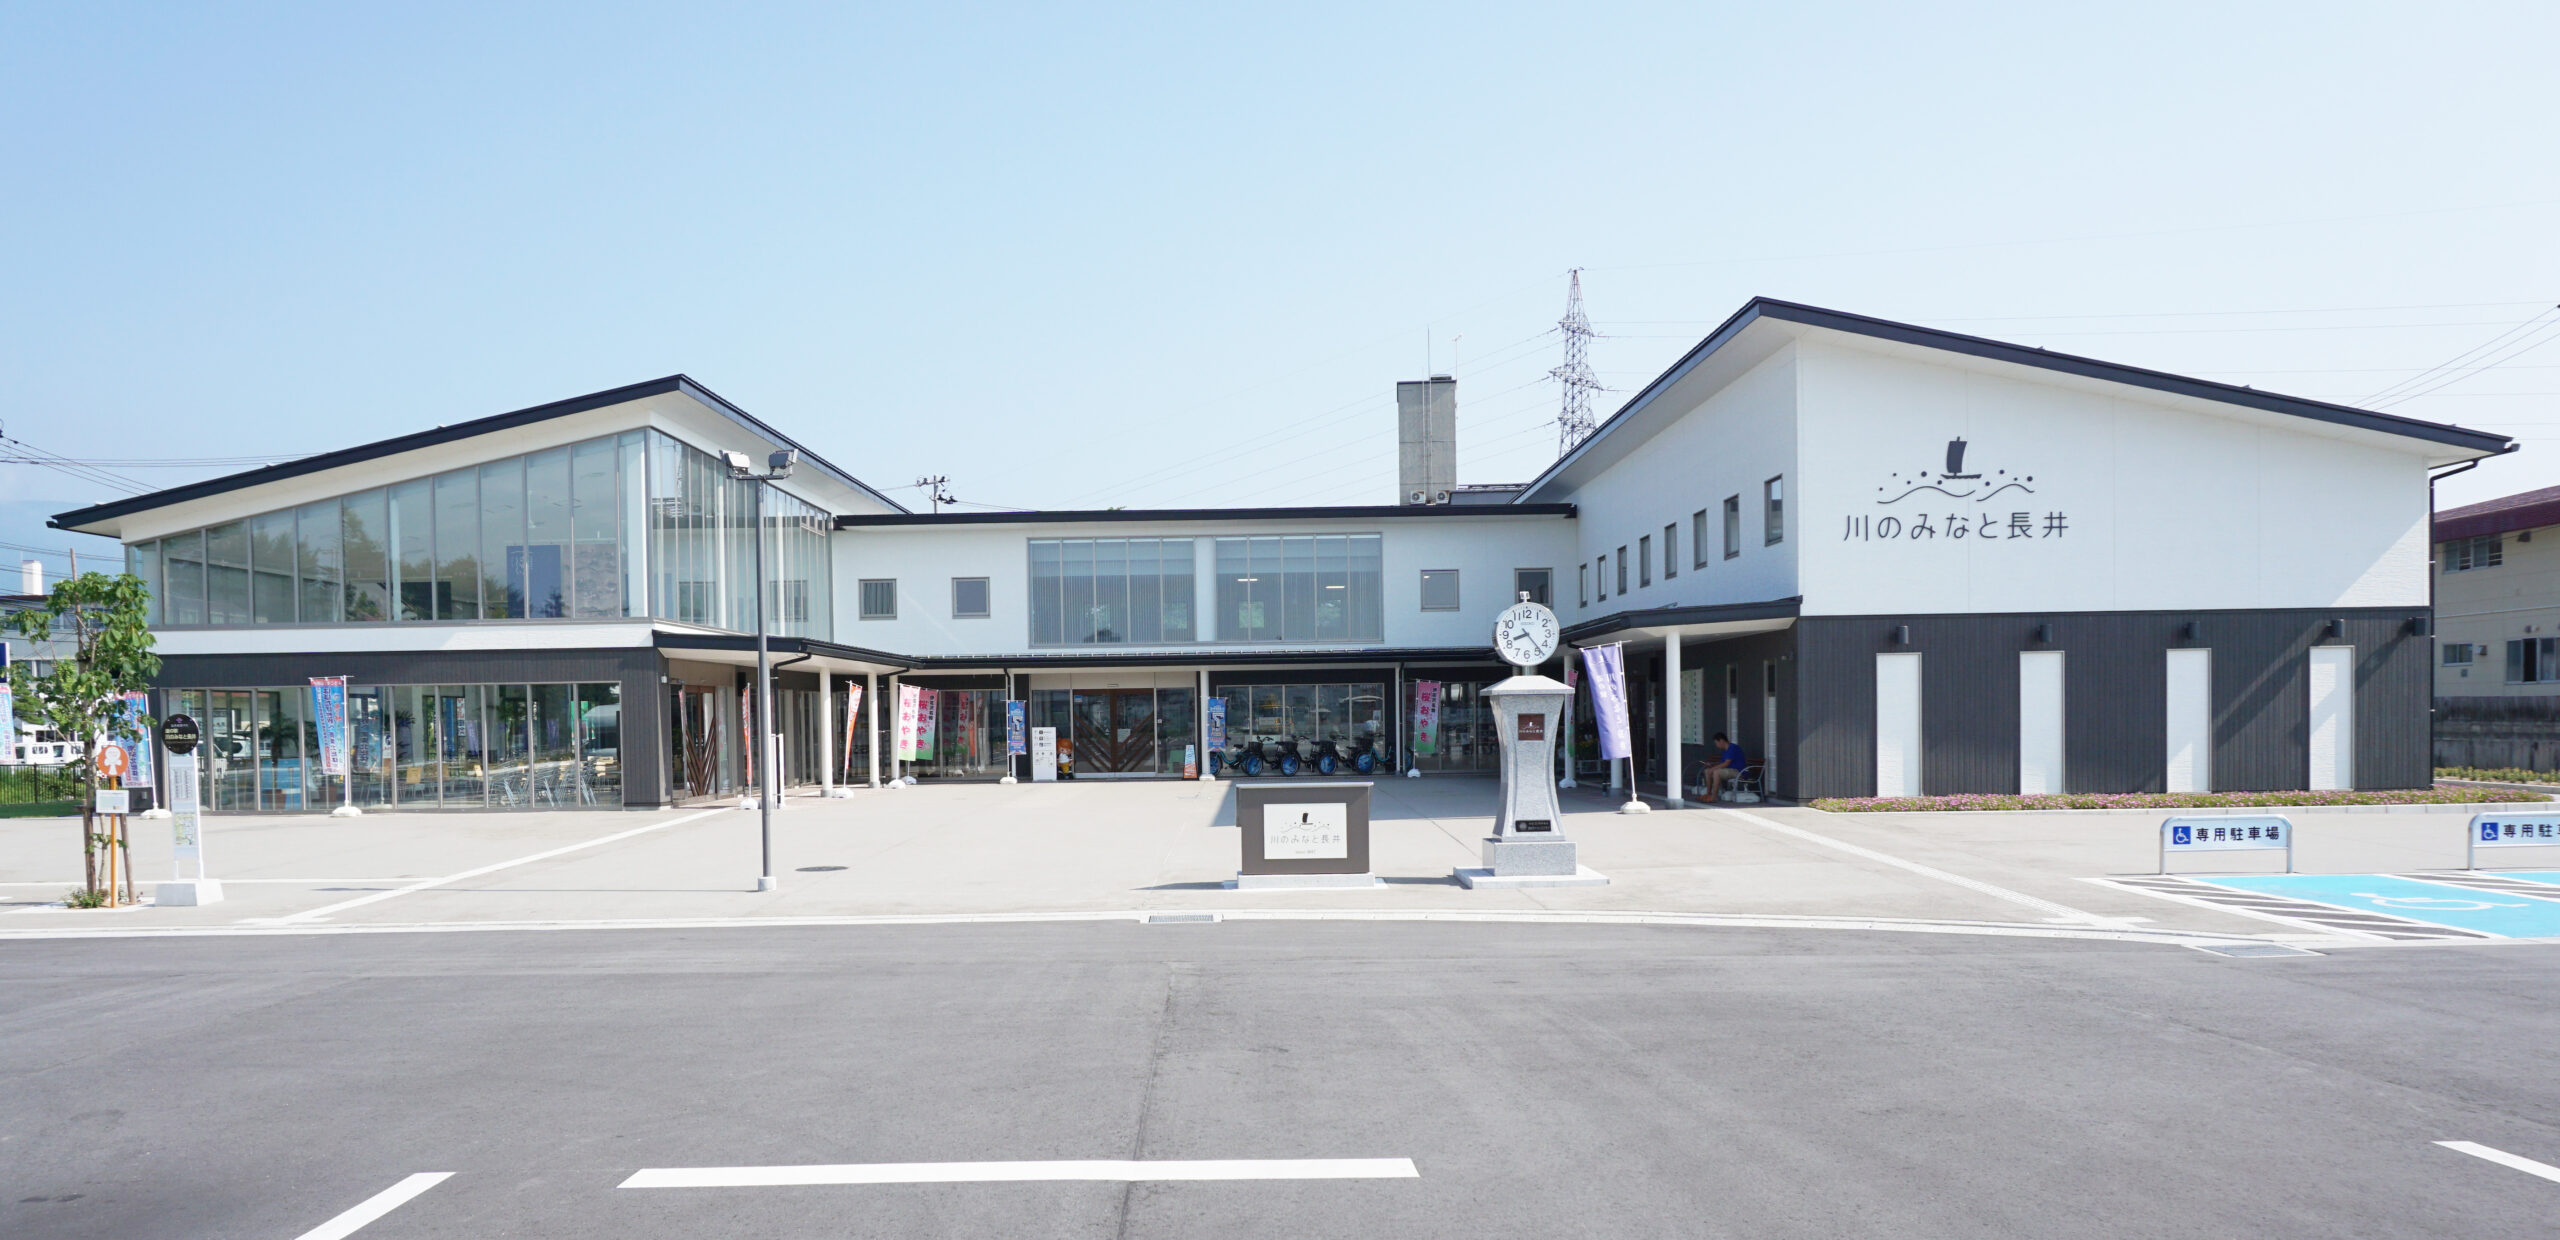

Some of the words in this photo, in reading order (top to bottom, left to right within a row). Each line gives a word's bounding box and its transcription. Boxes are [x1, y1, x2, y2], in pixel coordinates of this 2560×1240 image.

[1843, 511, 2069, 542] 川のみなと長井
[1513, 612, 1521, 621] 11
[1522, 609, 1532, 619] 12
[1502, 619, 1514, 630] 10
[1541, 618, 1548, 628] 2
[1502, 630, 1510, 640] 9
[1544, 629, 1552, 639] 3
[1506, 640, 1513, 650] 8
[1541, 639, 1548, 648] 4
[1514, 647, 1521, 657] 7
[1523, 649, 1531, 660] 6
[2196, 826, 2280, 842] 専用駐車場
[2503, 823, 2560, 838] 専用駐
[1270, 834, 1341, 845] 川のみなと長井
